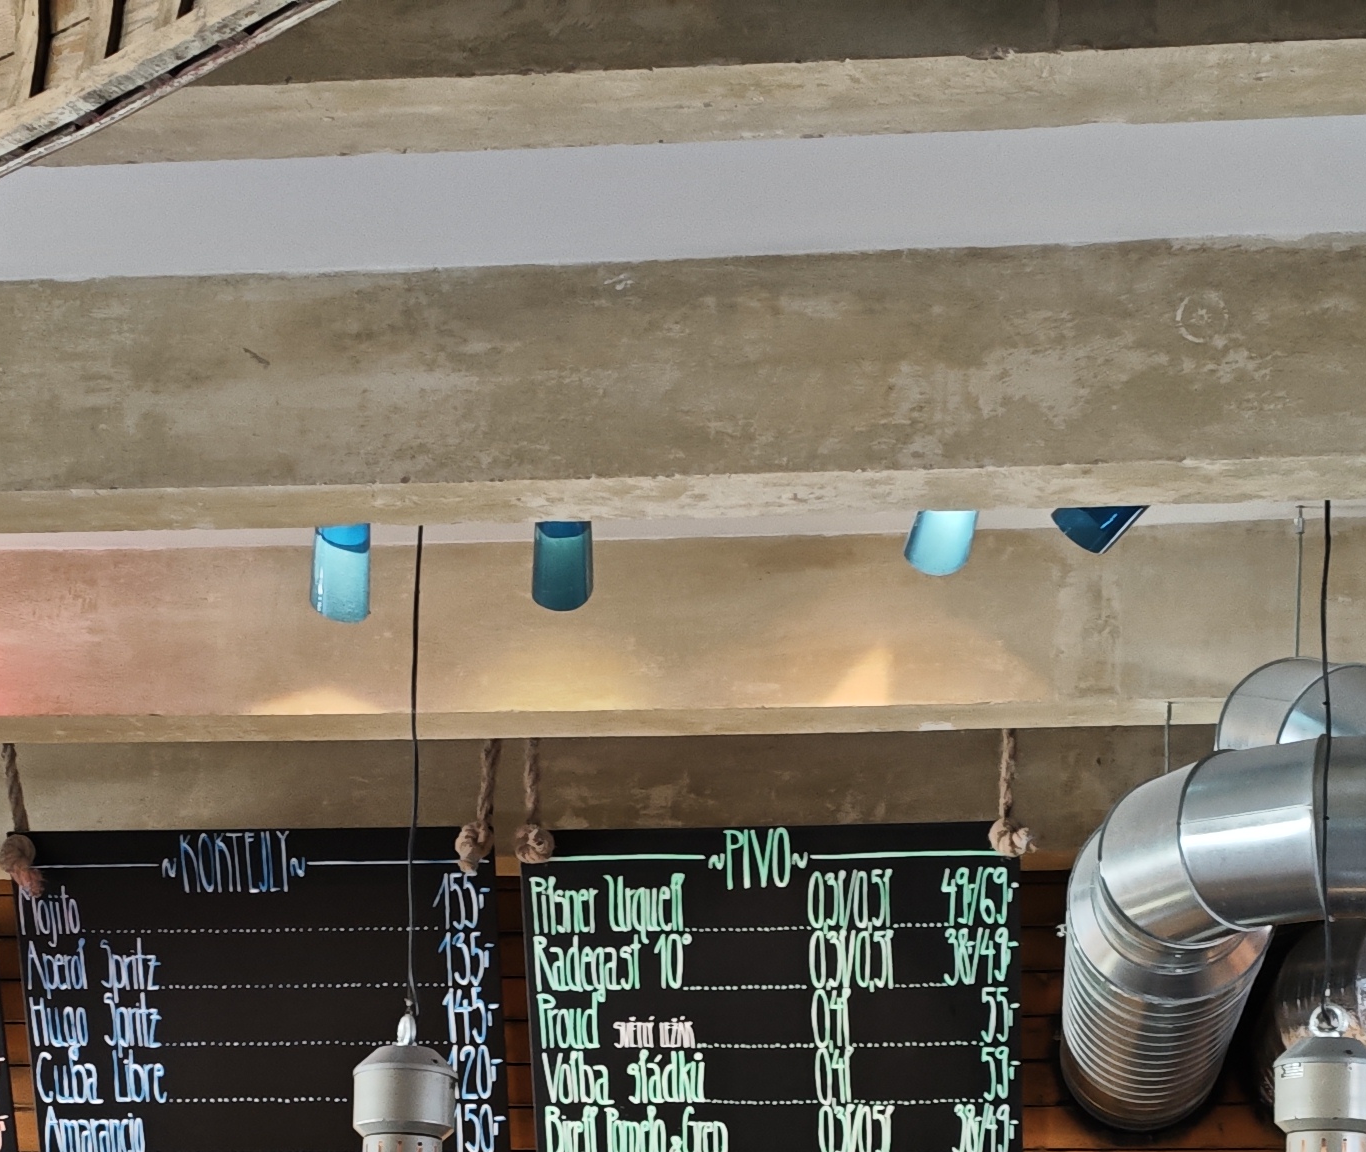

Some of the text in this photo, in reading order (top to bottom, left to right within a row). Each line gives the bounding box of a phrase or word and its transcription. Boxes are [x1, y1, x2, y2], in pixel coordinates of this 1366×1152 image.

[179, 831, 290, 893] KOKTEJLY
[723, 827, 791, 890] PIVO
[18, 885, 81, 948] Mojito
[529, 875, 598, 935] Pilsner
[603, 873, 685, 944] Urquell
[27, 938, 88, 999] Aperol
[100, 937, 161, 1003] Spritz
[532, 934, 641, 1002] Radegast
[654, 933, 692, 990] 10°
[29, 997, 89, 1061] Hugo
[103, 992, 162, 1058] Spritz
[536, 993, 600, 1049] Proud
[35, 1050, 104, 1104] Cuba
[112, 1049, 168, 1103] Libre
[541, 1050, 615, 1105] Volba
[626, 1049, 706, 1104] sládků
